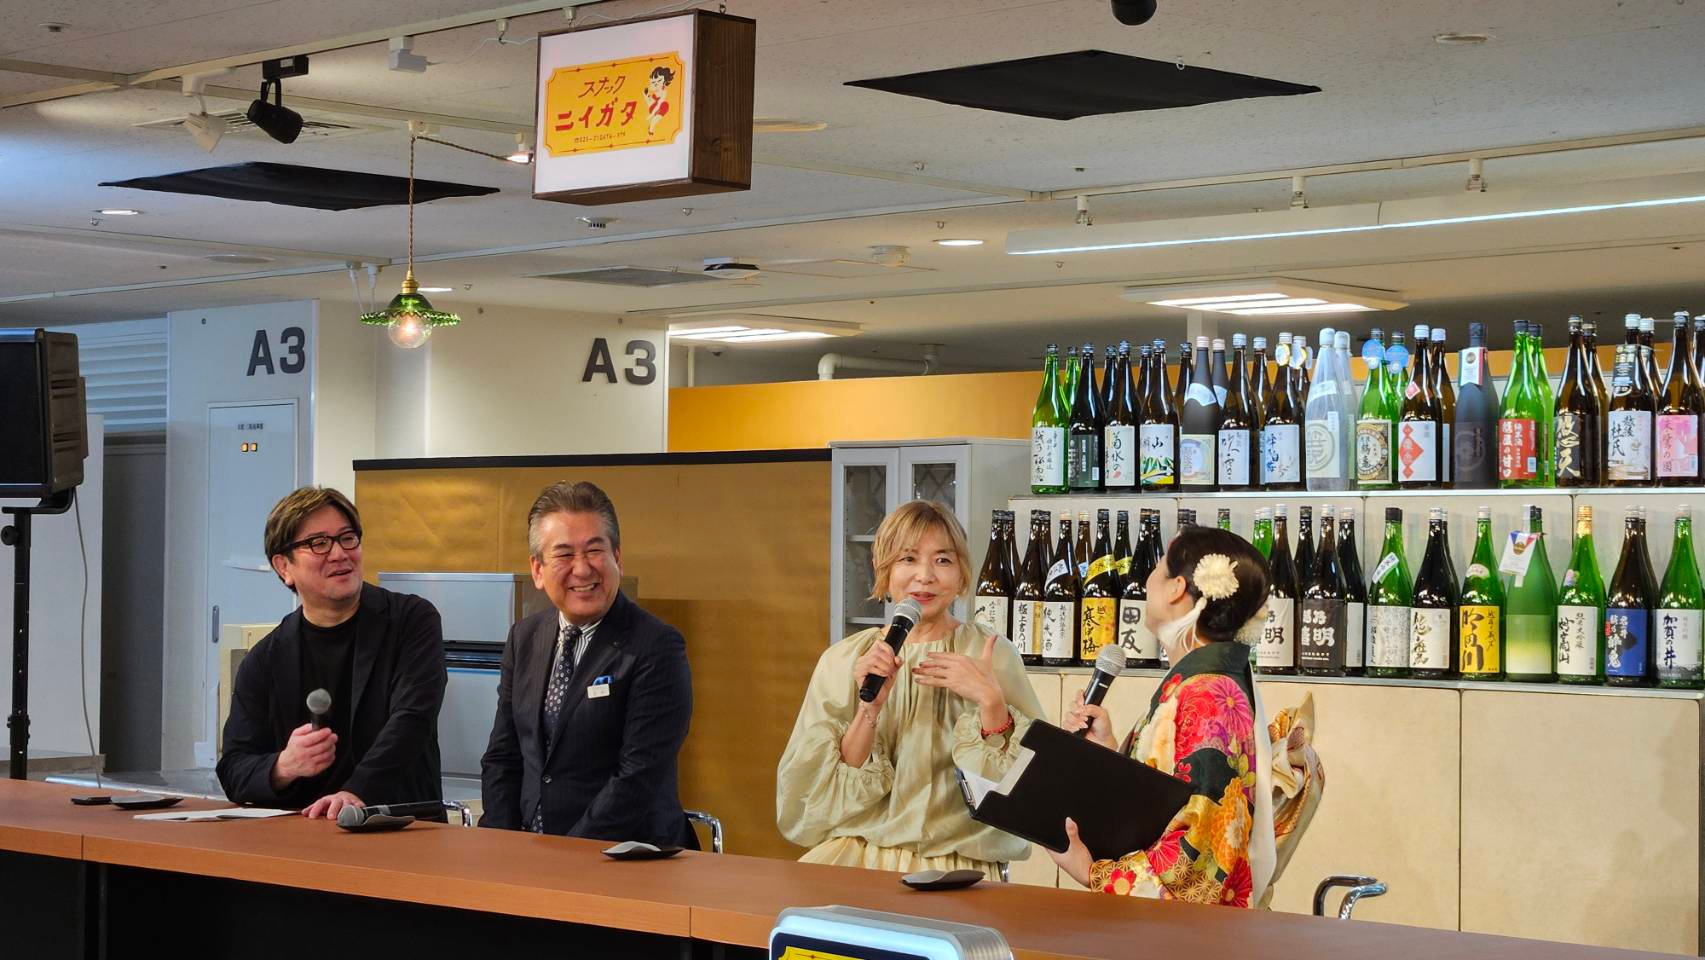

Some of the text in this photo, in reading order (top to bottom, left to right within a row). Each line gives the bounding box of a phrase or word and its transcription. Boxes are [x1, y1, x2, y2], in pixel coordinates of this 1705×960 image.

[578, 76, 626, 98] スナック
[555, 97, 637, 131] ニイガタ
[247, 327, 306, 376] A3
[583, 337, 657, 386] A3
[1611, 420, 1626, 458] 杜氏
[1121, 606, 1142, 654] 田友
[1662, 613, 1679, 670] 加賀の井
